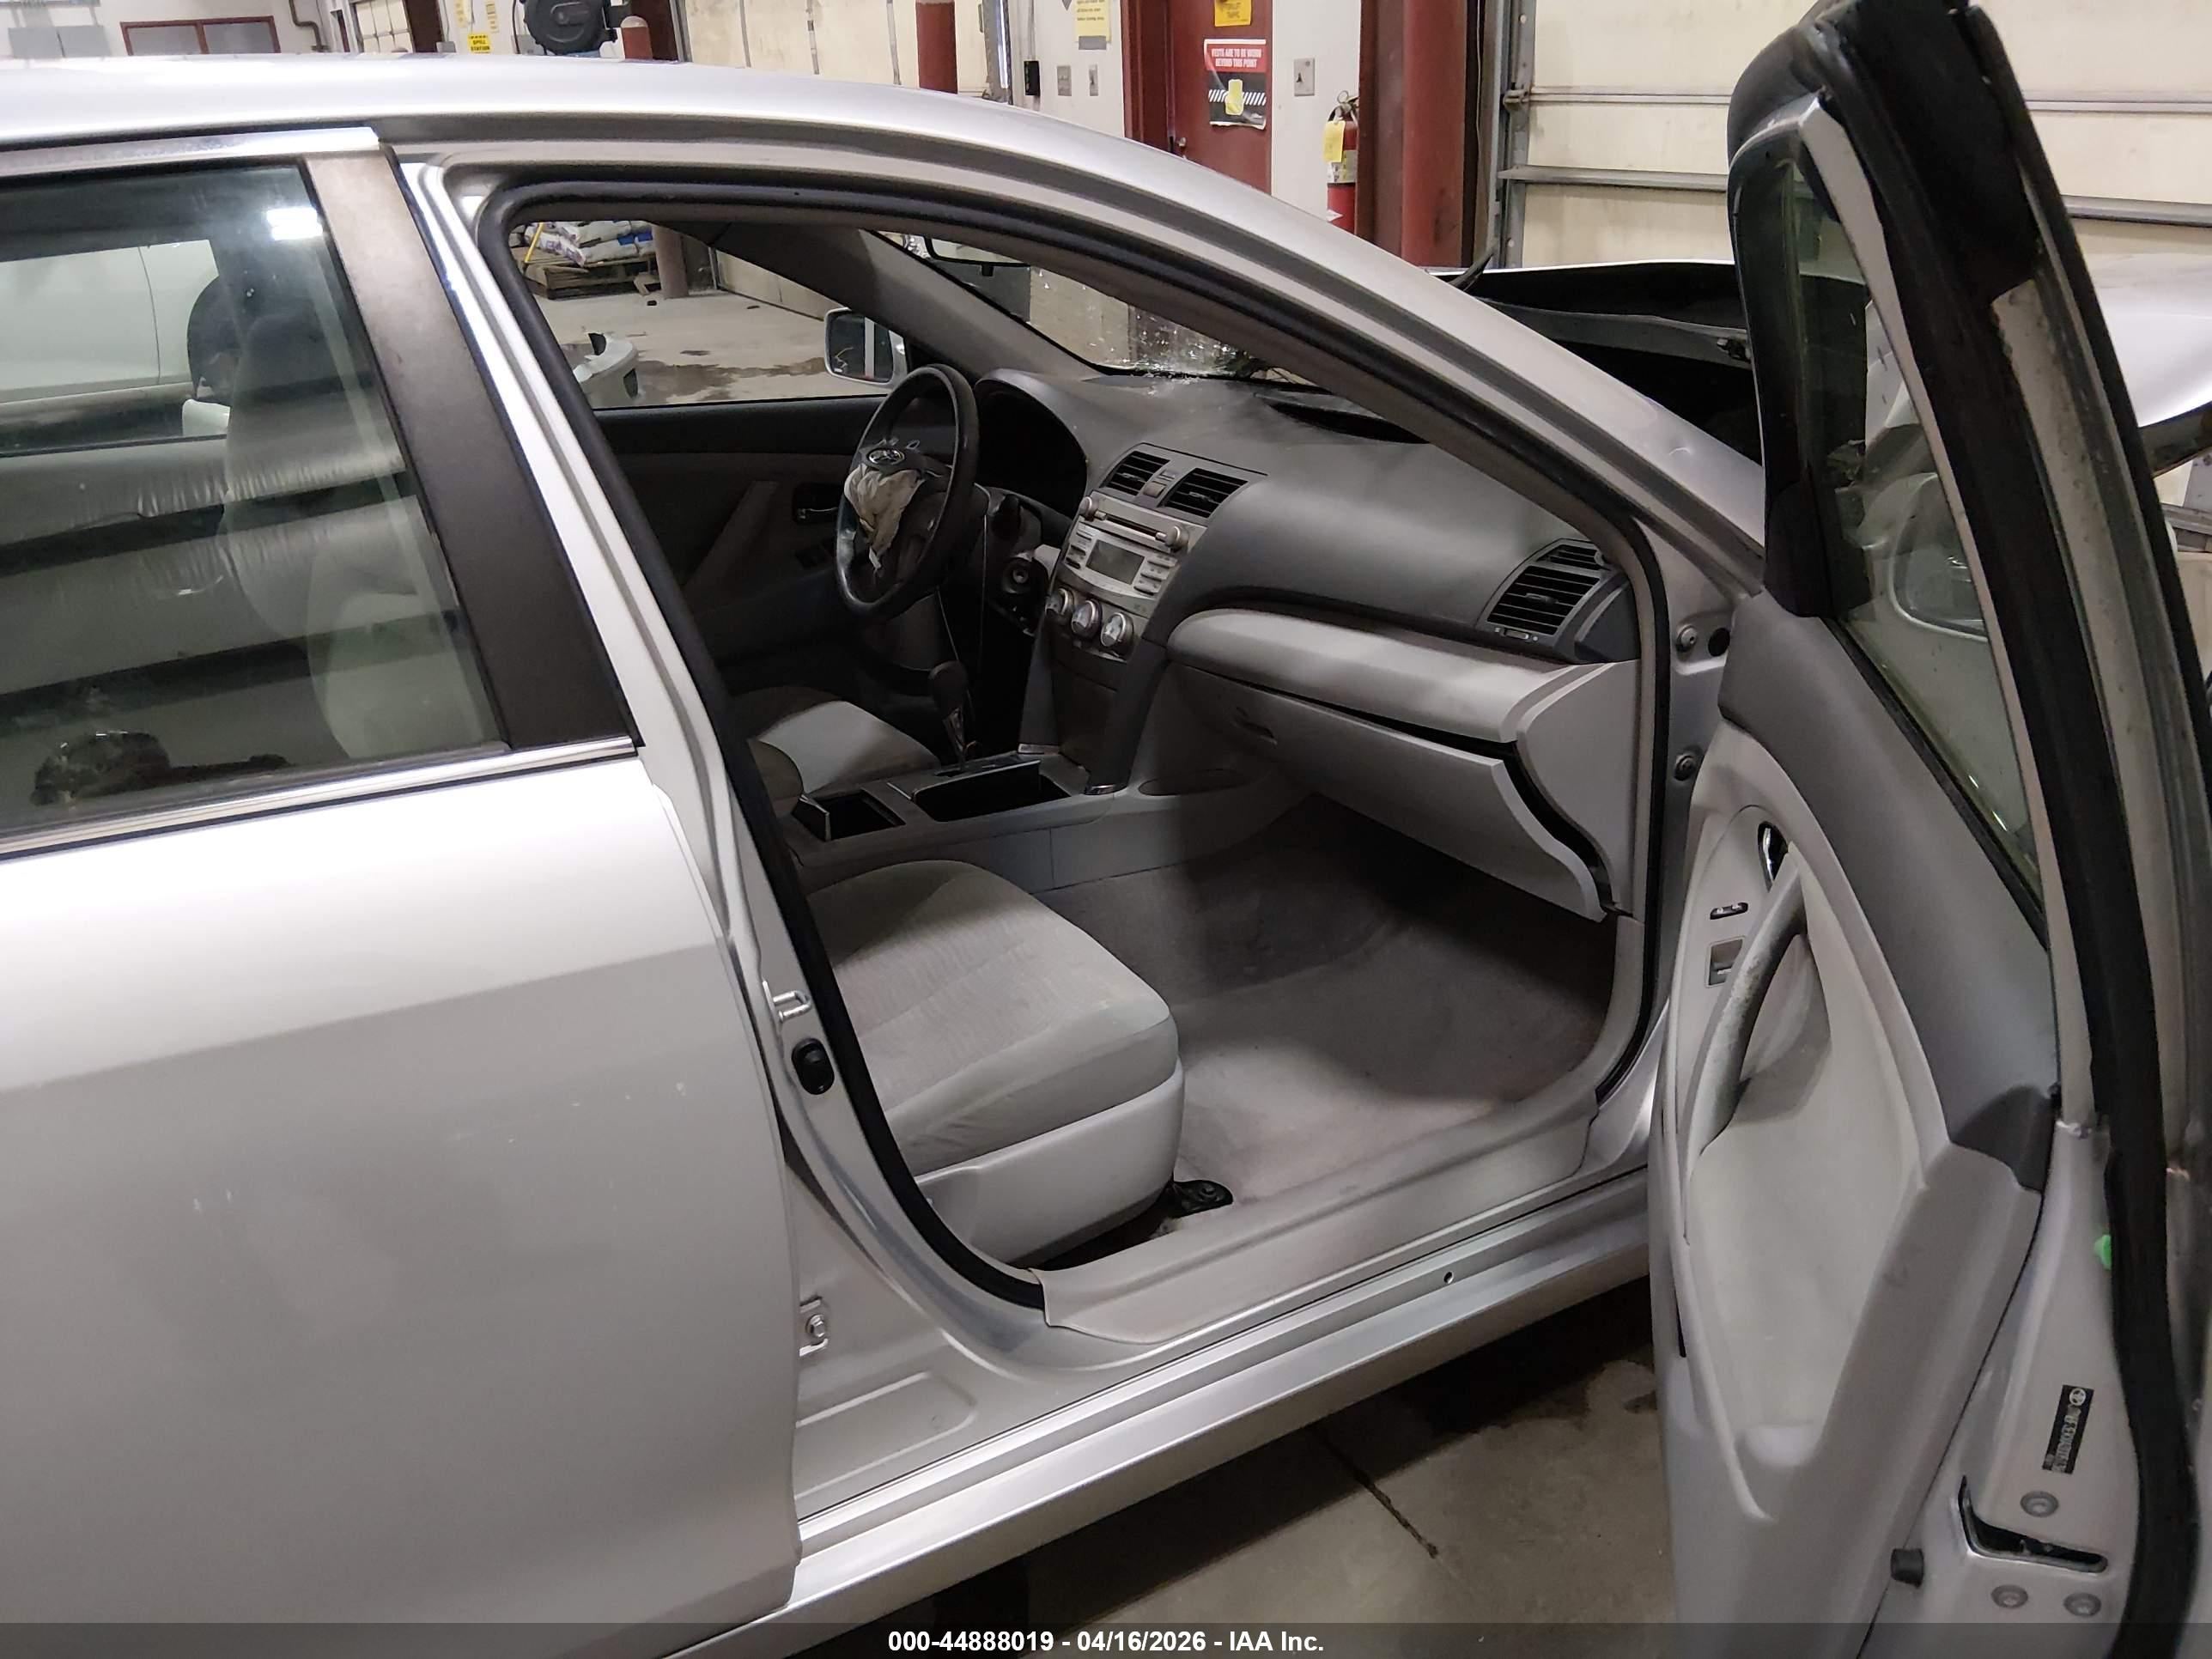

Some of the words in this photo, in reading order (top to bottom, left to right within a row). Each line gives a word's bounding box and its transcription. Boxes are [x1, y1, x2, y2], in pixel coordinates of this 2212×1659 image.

[1225, 48, 1234, 58] ARE
[1234, 48, 1241, 58] TO
[1241, 48, 1247, 58] BE
[1233, 58, 1243, 68] THIS
[1243, 58, 1257, 68] POINT
